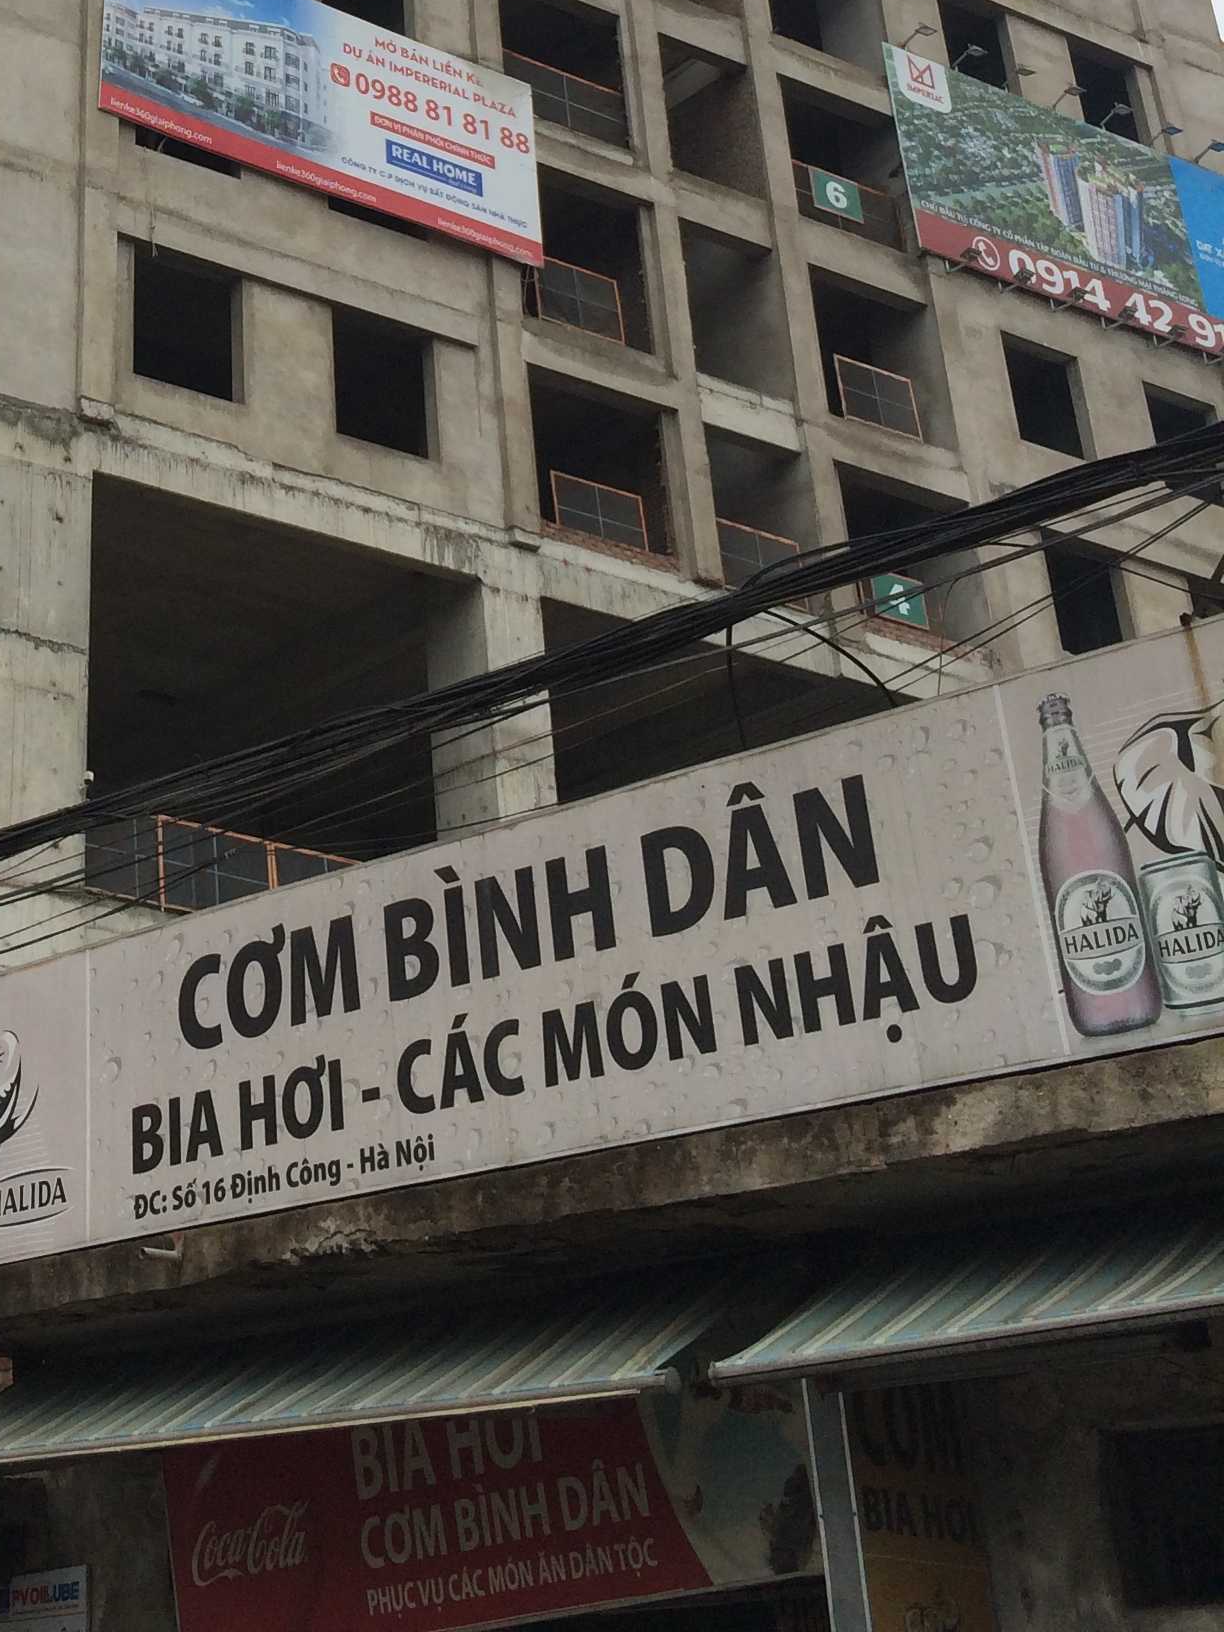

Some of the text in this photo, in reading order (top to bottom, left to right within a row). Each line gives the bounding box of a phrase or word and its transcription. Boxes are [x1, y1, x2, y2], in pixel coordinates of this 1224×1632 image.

[355, 73, 531, 154] 0988 81 81 88
[473, 93, 517, 118] PLAZA
[391, 144, 431, 170] REAL
[432, 159, 477, 186] HOME
[826, 181, 847, 208] 6
[1009, 249, 1111, 312] 0914
[1126, 292, 1173, 333] 42
[1047, 758, 1084, 773] HALIDA
[177, 774, 880, 1051] CƠM BÌNH DÂN
[1064, 923, 1139, 955] HALIDA
[1158, 928, 1224, 959] HALIDA
[130, 1090, 223, 1175] BIA
[239, 1054, 345, 1152] HƠI
[396, 1011, 525, 1116] CÁC
[542, 972, 718, 1089] MÓN
[734, 913, 979, 1046] NHẬU
[133, 1191, 168, 1219] ĐC:
[172, 1178, 197, 1212] Số
[202, 1177, 226, 1205] 16
[230, 1169, 281, 1204] Định
[286, 1157, 342, 1187] Công
[359, 1144, 390, 1174] Hà
[395, 1133, 435, 1172] Nội
[351, 1421, 437, 1501] BIA
[361, 1458, 651, 1569] CƠM BÌNH DÂN
[366, 1536, 659, 1619] PHỤC VỤ CÁC MÓN ĂN DÂN TỘC
